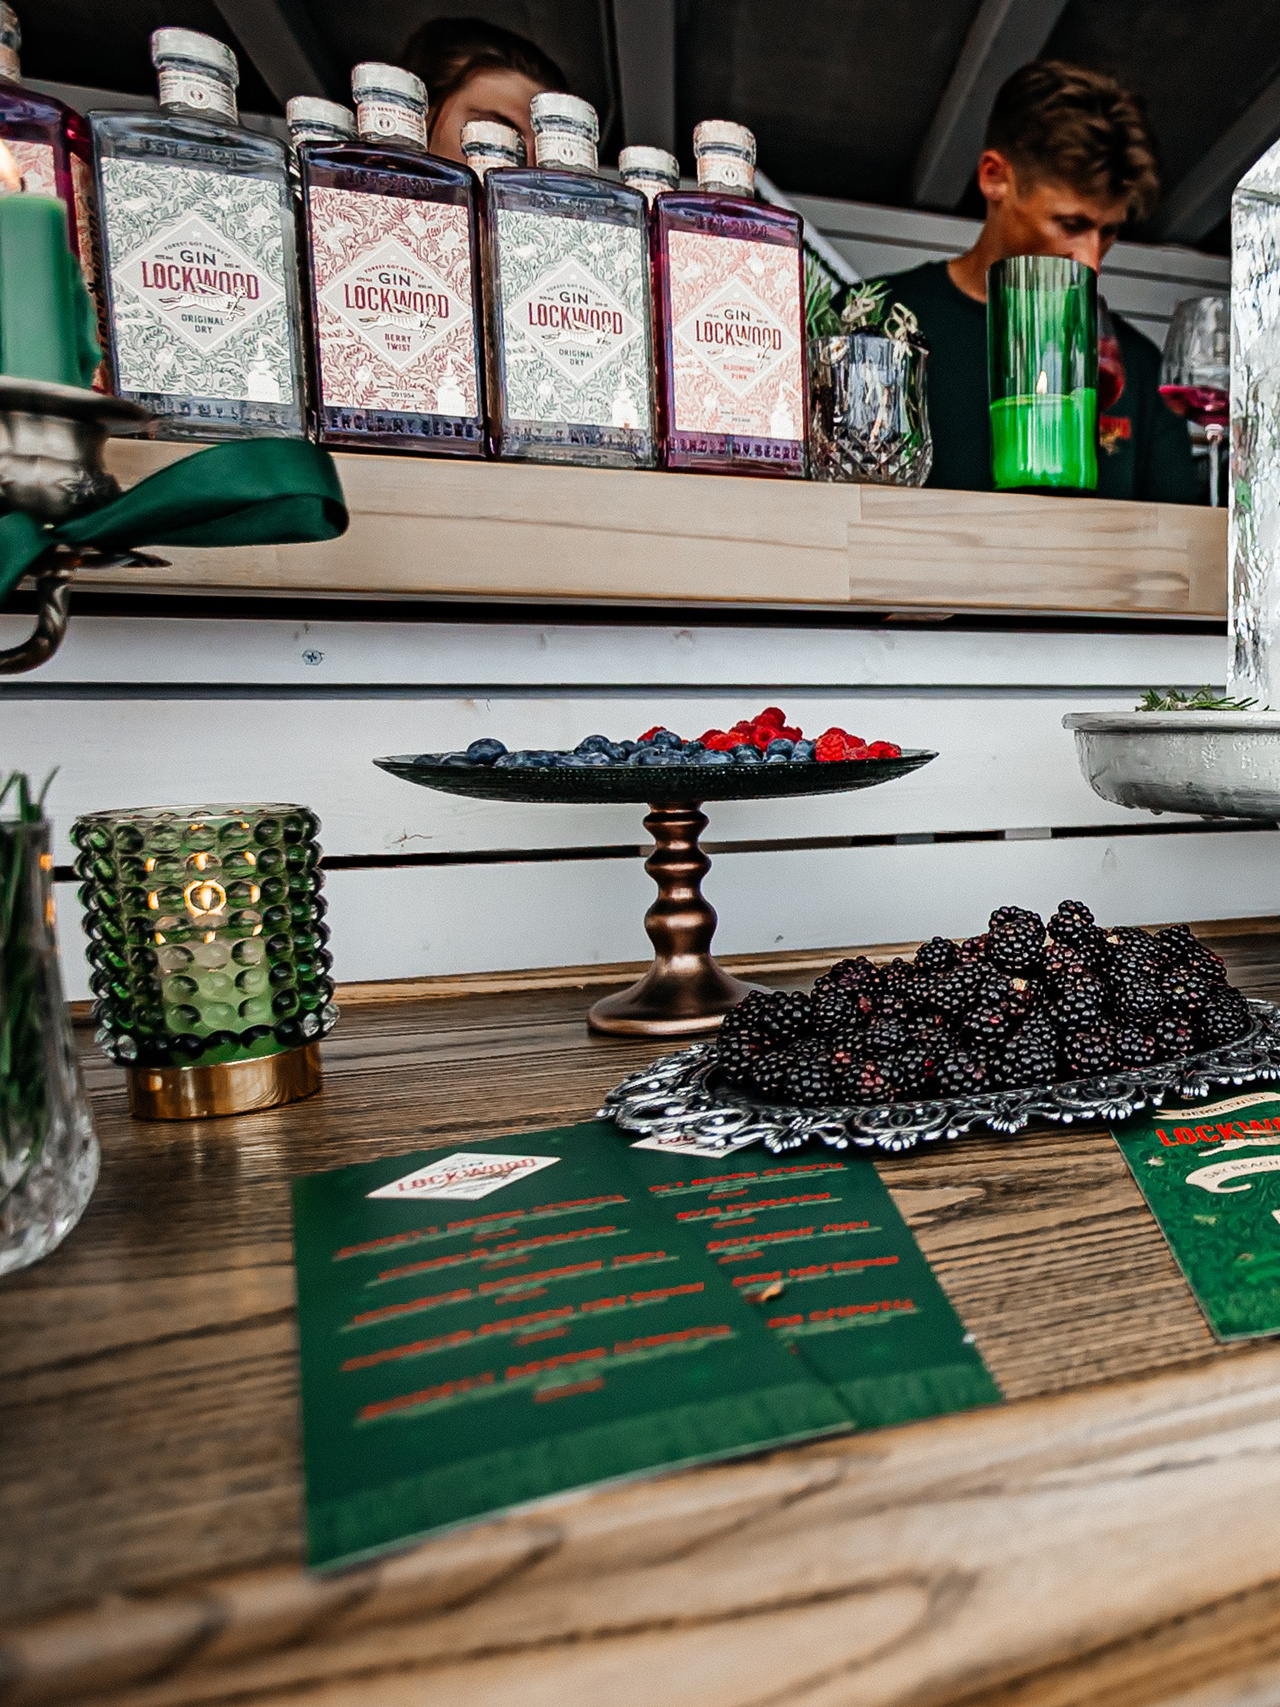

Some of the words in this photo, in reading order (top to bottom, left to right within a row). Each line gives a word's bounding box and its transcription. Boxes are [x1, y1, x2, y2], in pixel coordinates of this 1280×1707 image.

[180, 249, 216, 266] GIN
[141, 261, 259, 300] LOCKWOOD
[378, 272, 411, 287] GIN
[344, 284, 449, 319] LOCKWOOD
[559, 291, 589, 305] GIN
[181, 313, 225, 326] ORIGINAL
[528, 302, 623, 334] LOCKWOOD
[724, 309, 750, 321] GIN
[194, 325, 213, 334] DRY
[695, 320, 782, 350] LOCKWOOD
[384, 333, 412, 343] BERRY
[386, 342, 411, 352] TWIST
[559, 348, 594, 359] ORIGINAL
[1231, 1160, 1279, 1170] BEACH
[397, 1158, 535, 1192] LOCKWOOD
